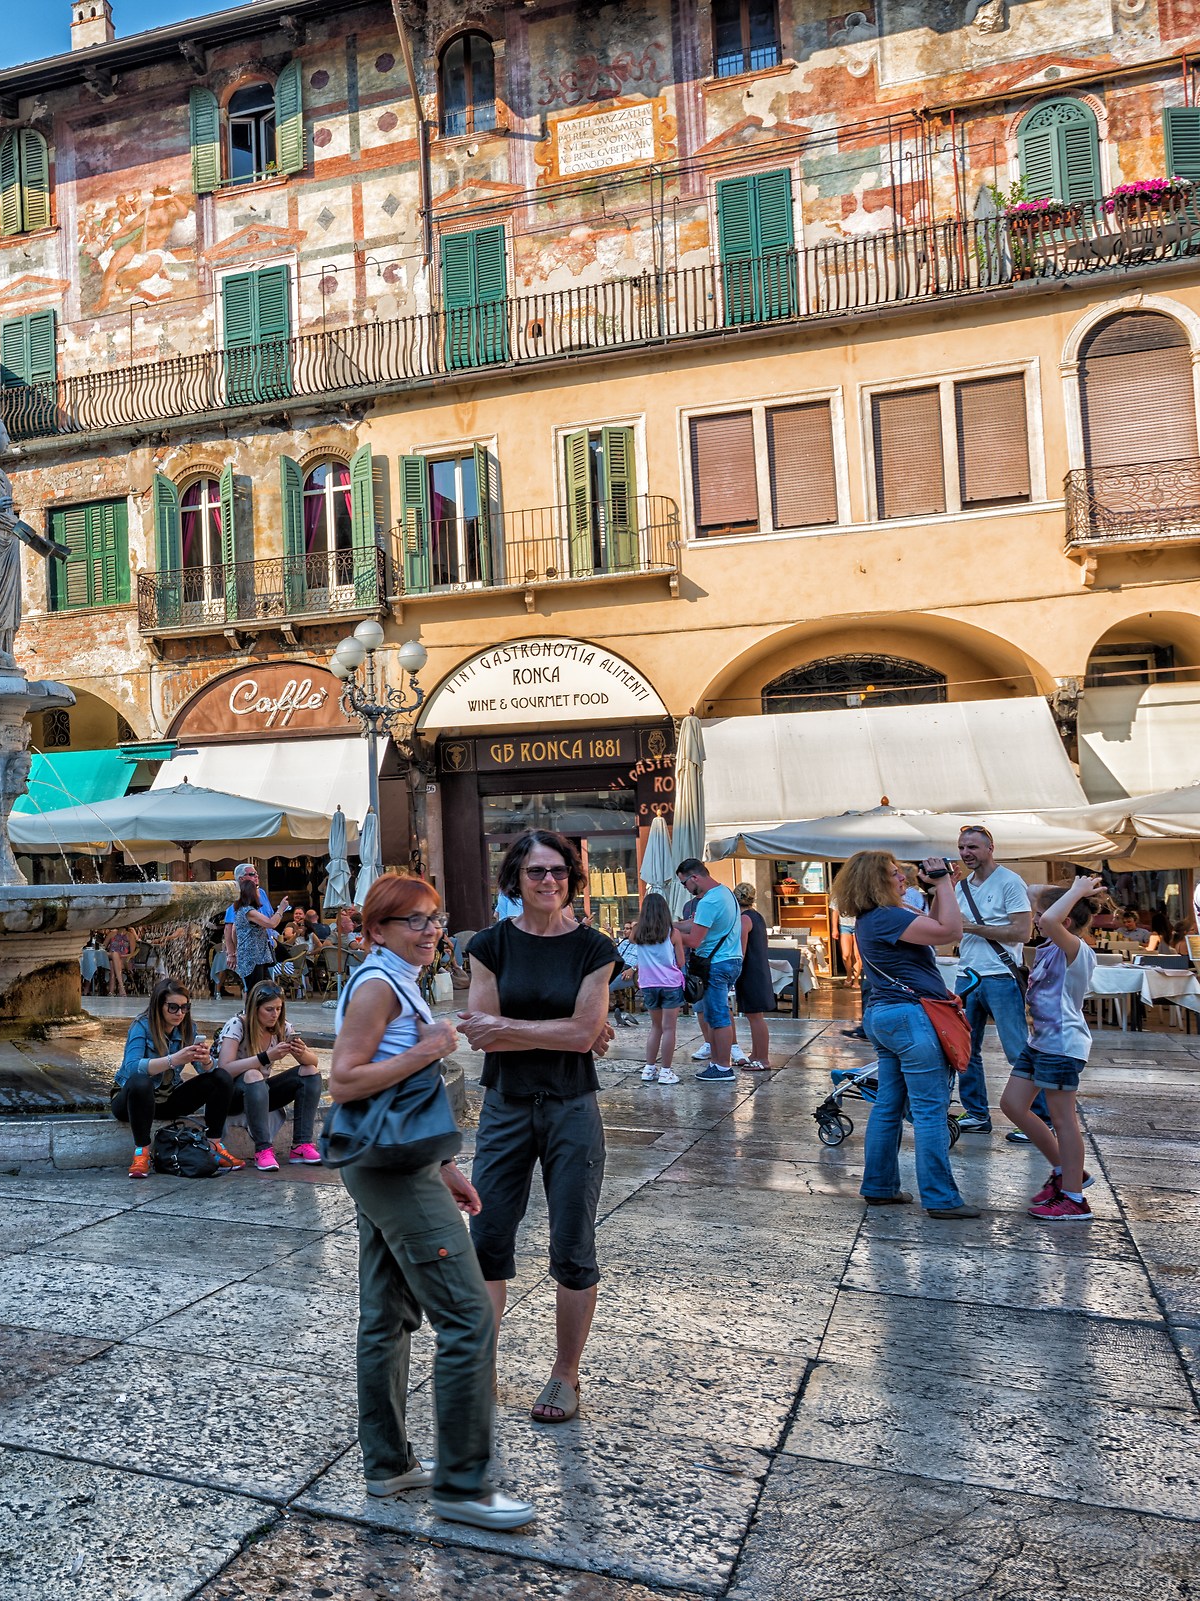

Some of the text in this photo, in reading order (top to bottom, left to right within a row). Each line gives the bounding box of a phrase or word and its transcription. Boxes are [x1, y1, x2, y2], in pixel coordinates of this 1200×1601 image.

[444, 642, 650, 702] VINI GASTRONOMIA ALIMENTI
[512, 665, 560, 686] RONCA
[228, 678, 329, 727] Caffè
[467, 692, 609, 712] WINE & GOURMET FOOD
[489, 738, 621, 763] GB RONCA 1881
